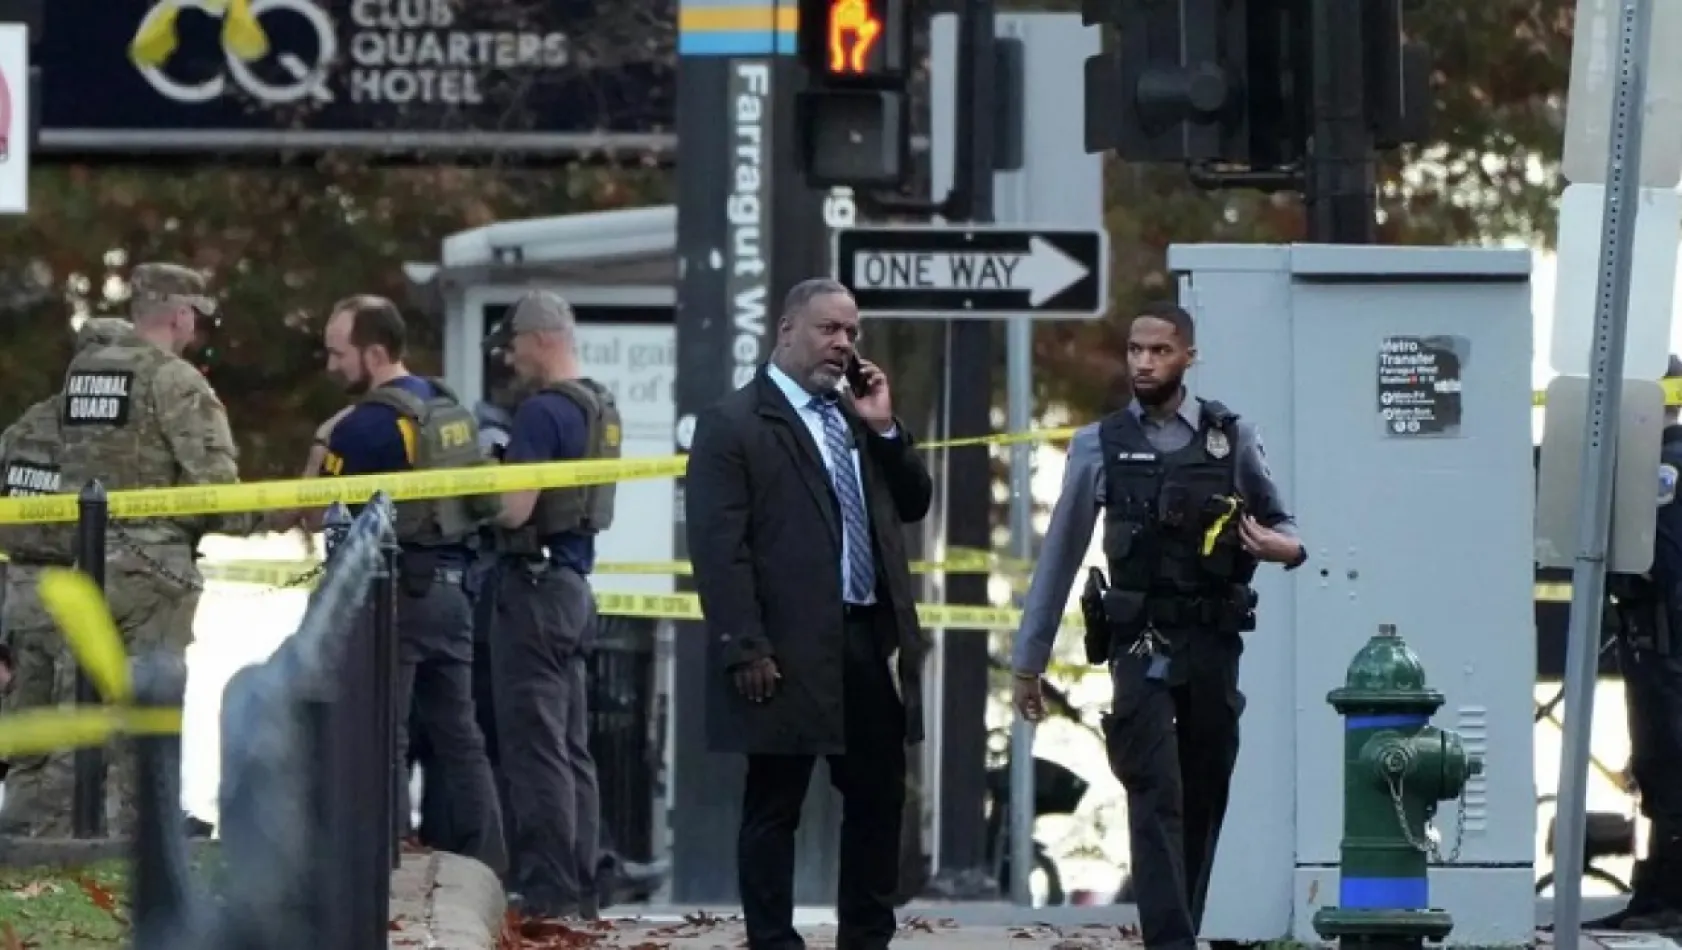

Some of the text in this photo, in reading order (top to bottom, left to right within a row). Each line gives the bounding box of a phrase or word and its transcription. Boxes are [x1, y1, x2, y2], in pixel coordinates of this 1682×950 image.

[351, 0, 453, 28] CLUB
[351, 32, 568, 67] QUARTERS
[351, 69, 484, 104] HOTEL
[727, 64, 768, 391] Farragut Wes
[864, 254, 1020, 288] ONE WAY
[572, 337, 619, 366] tal
[1380, 352, 1435, 365] Transfer
[1382, 339, 1418, 353] Metro
[68, 375, 128, 396] NATIONAL
[70, 397, 119, 418] GUARD
[440, 420, 472, 449] FBI
